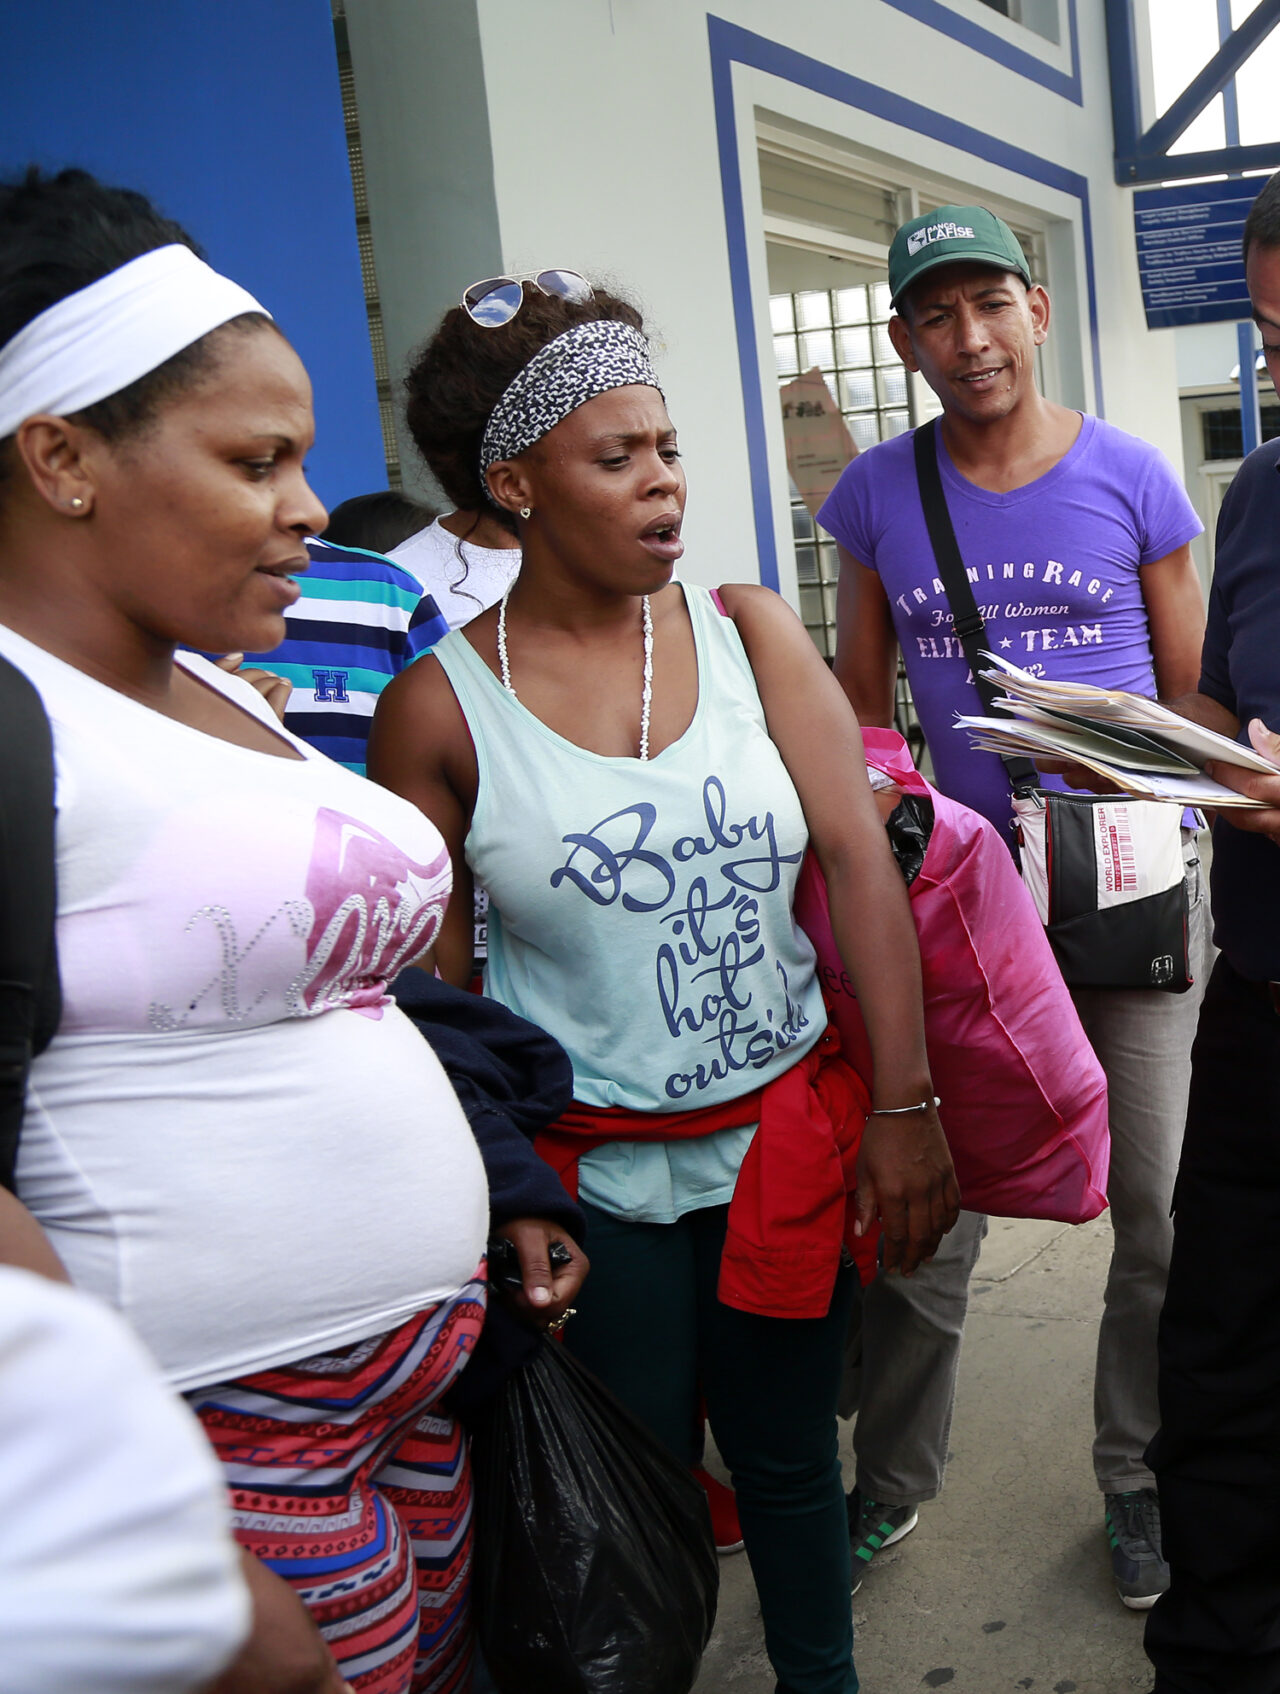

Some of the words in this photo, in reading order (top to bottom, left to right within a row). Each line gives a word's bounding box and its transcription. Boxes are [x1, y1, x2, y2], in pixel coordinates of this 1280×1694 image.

[927, 222, 956, 233] BANCO
[927, 226, 976, 242] LAFISE
[896, 562, 1035, 616] TRANING
[930, 609, 955, 627] Fo
[1004, 602, 1070, 618] Women
[916, 637, 965, 659] ELIT
[1021, 624, 1104, 652] TEAM
[312, 669, 350, 703] H
[550, 775, 802, 912] Baby
[1098, 807, 1110, 856] EXPLORER
[1104, 857, 1113, 892] WORLD
[659, 876, 760, 965] it's
[656, 931, 765, 1038] hot
